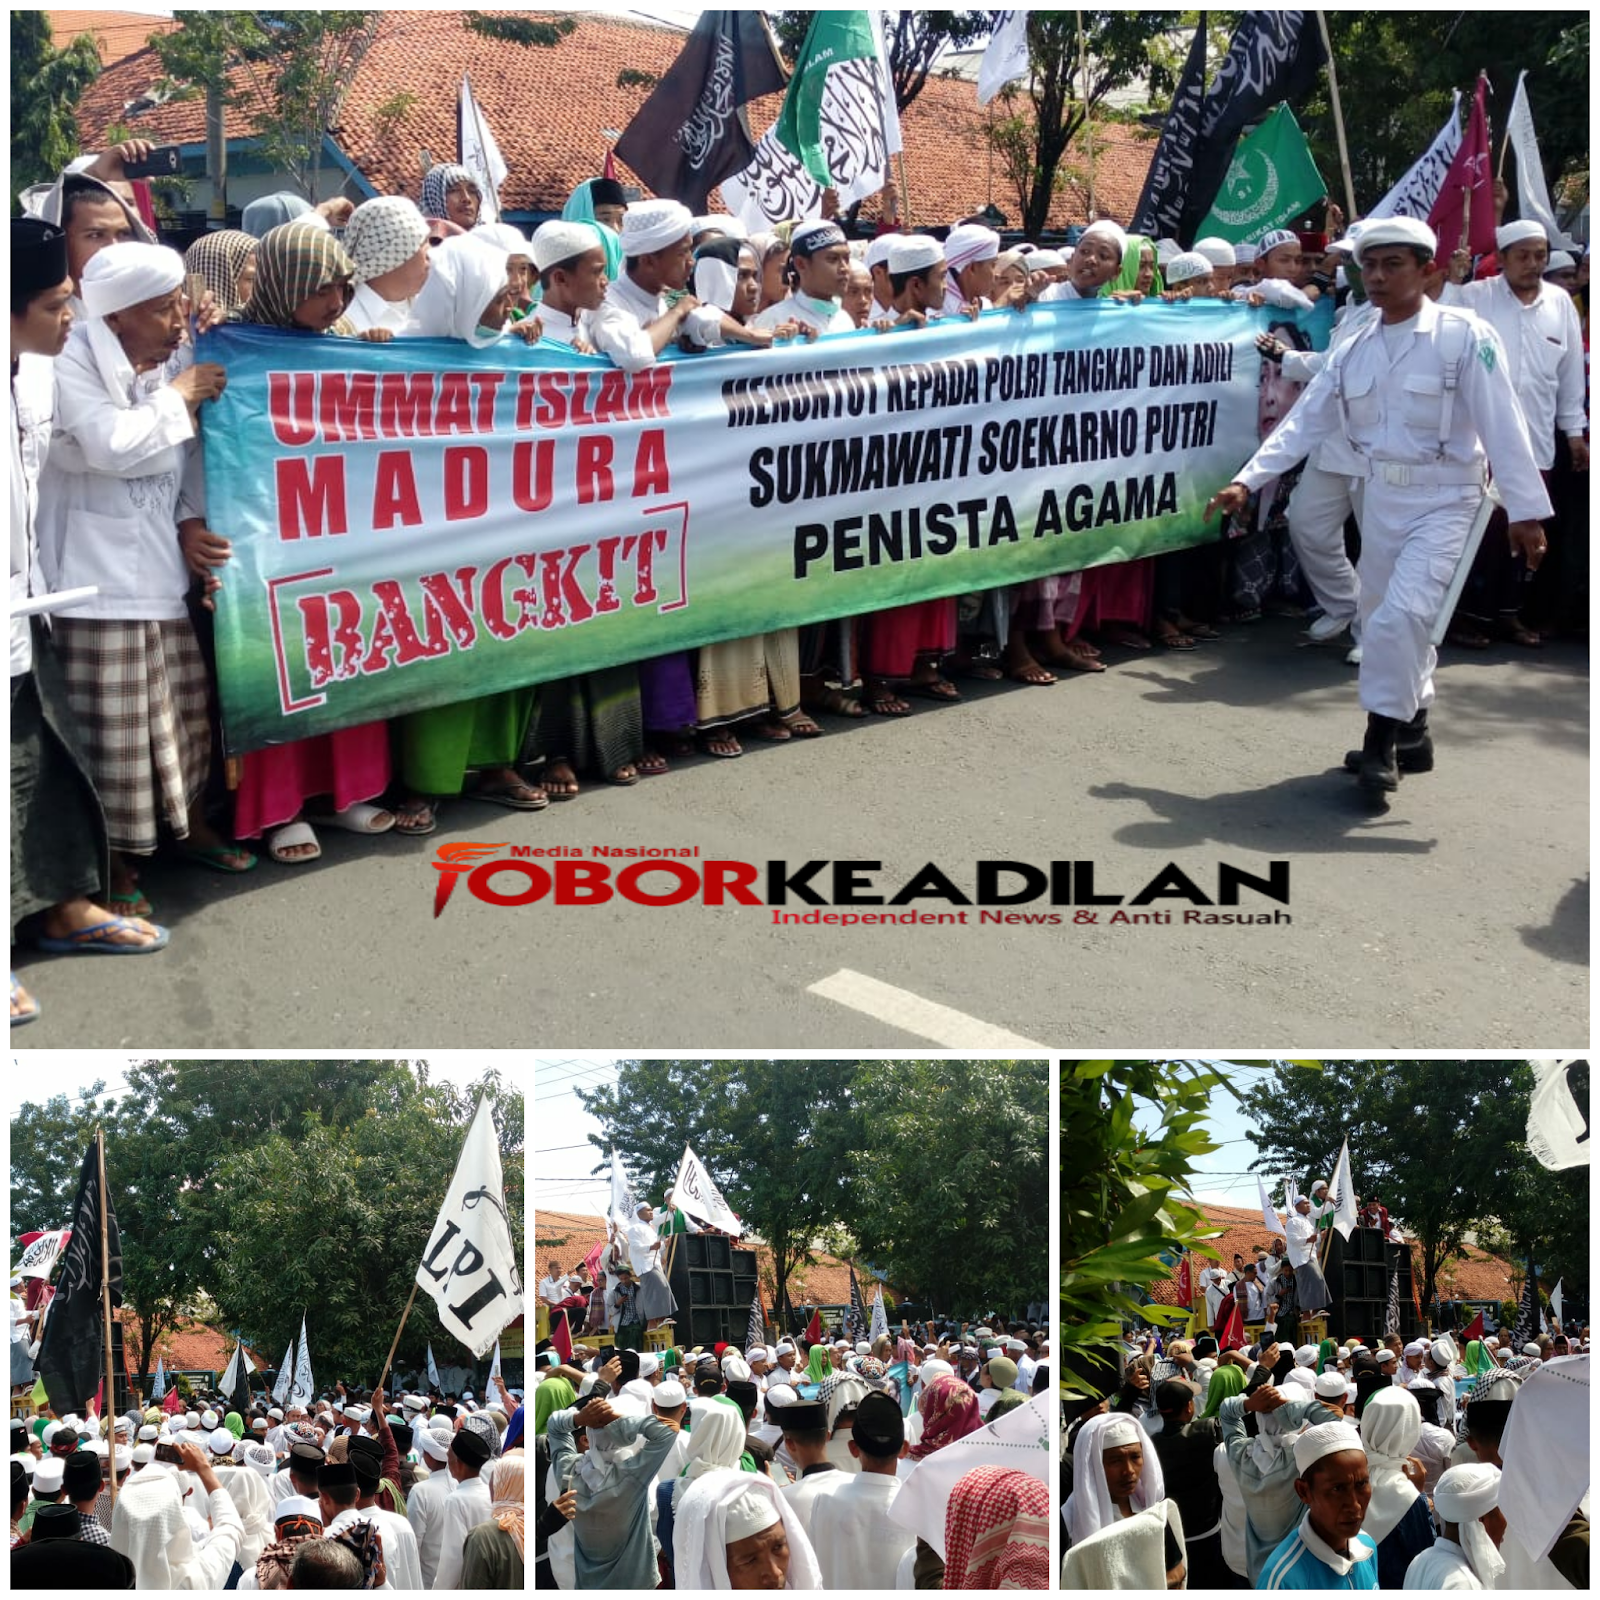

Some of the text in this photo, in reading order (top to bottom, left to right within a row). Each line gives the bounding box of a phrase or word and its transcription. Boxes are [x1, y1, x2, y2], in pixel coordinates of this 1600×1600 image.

[268, 364, 675, 446] UMMAT ISLAM
[721, 341, 1234, 428] MENUNTUT KEPADA POLRI TANGKAP DAN ADILI
[275, 429, 671, 541] MADURA
[749, 399, 1219, 508] SUKMAWATI SOEKARNO PUTRI
[793, 471, 1179, 580] PENISTA AGAMA
[297, 528, 668, 688] BANGKIT
[422, 1218, 507, 1331] LPI
